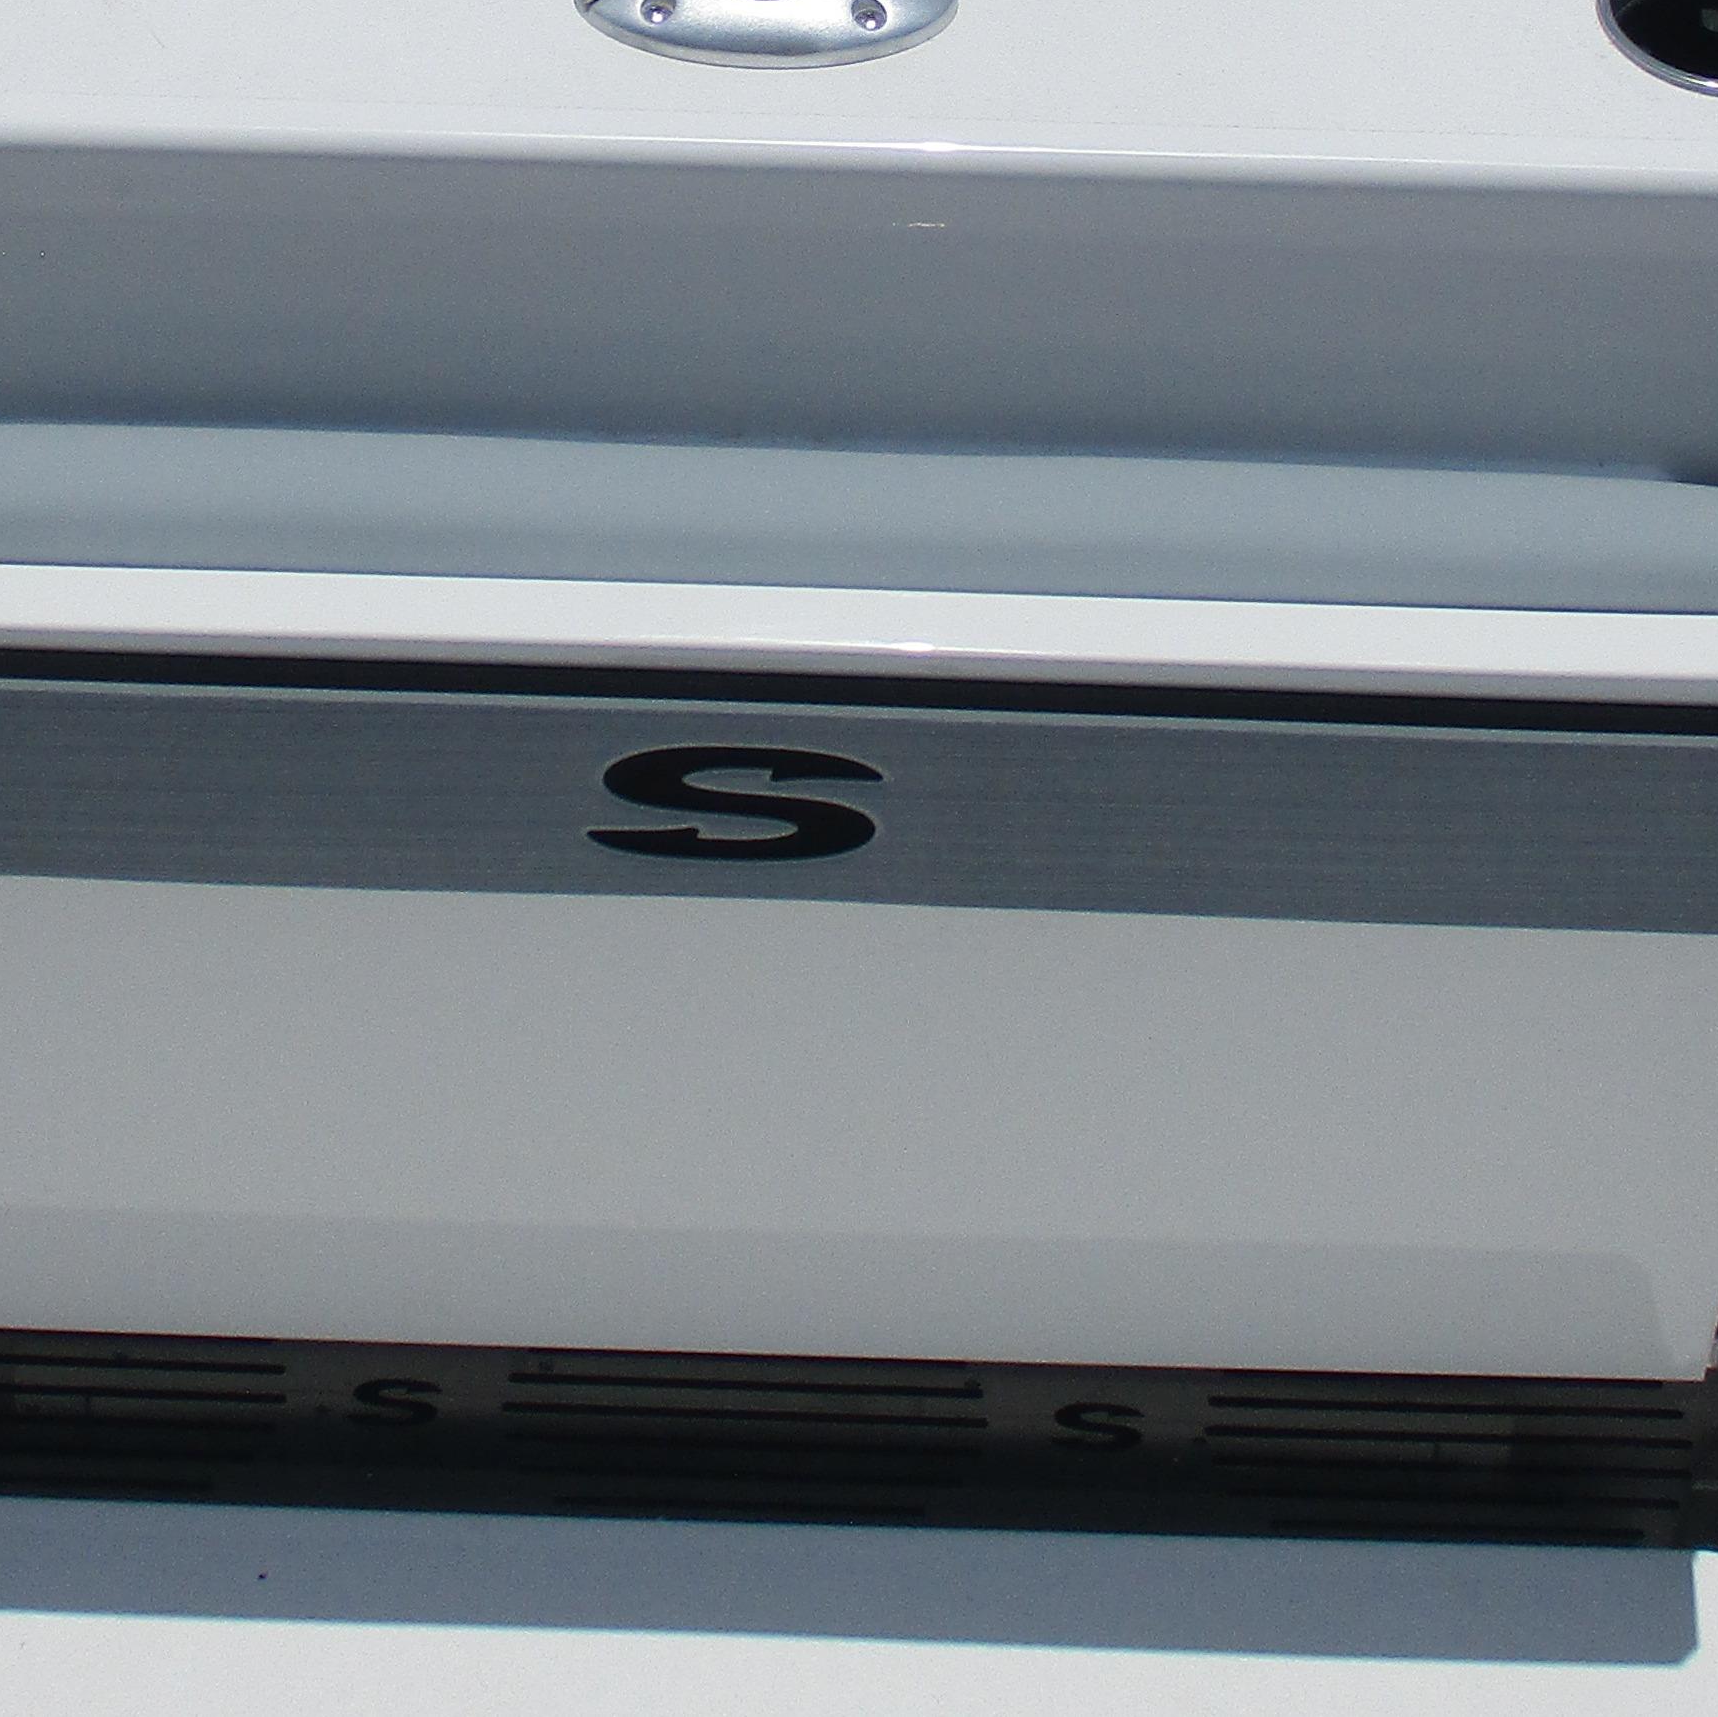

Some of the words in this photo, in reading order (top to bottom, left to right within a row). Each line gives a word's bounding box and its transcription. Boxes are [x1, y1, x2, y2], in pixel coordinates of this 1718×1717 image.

[586, 746, 883, 861] S
[345, 1378, 442, 1425] S
[1051, 1402, 1144, 1449] S
